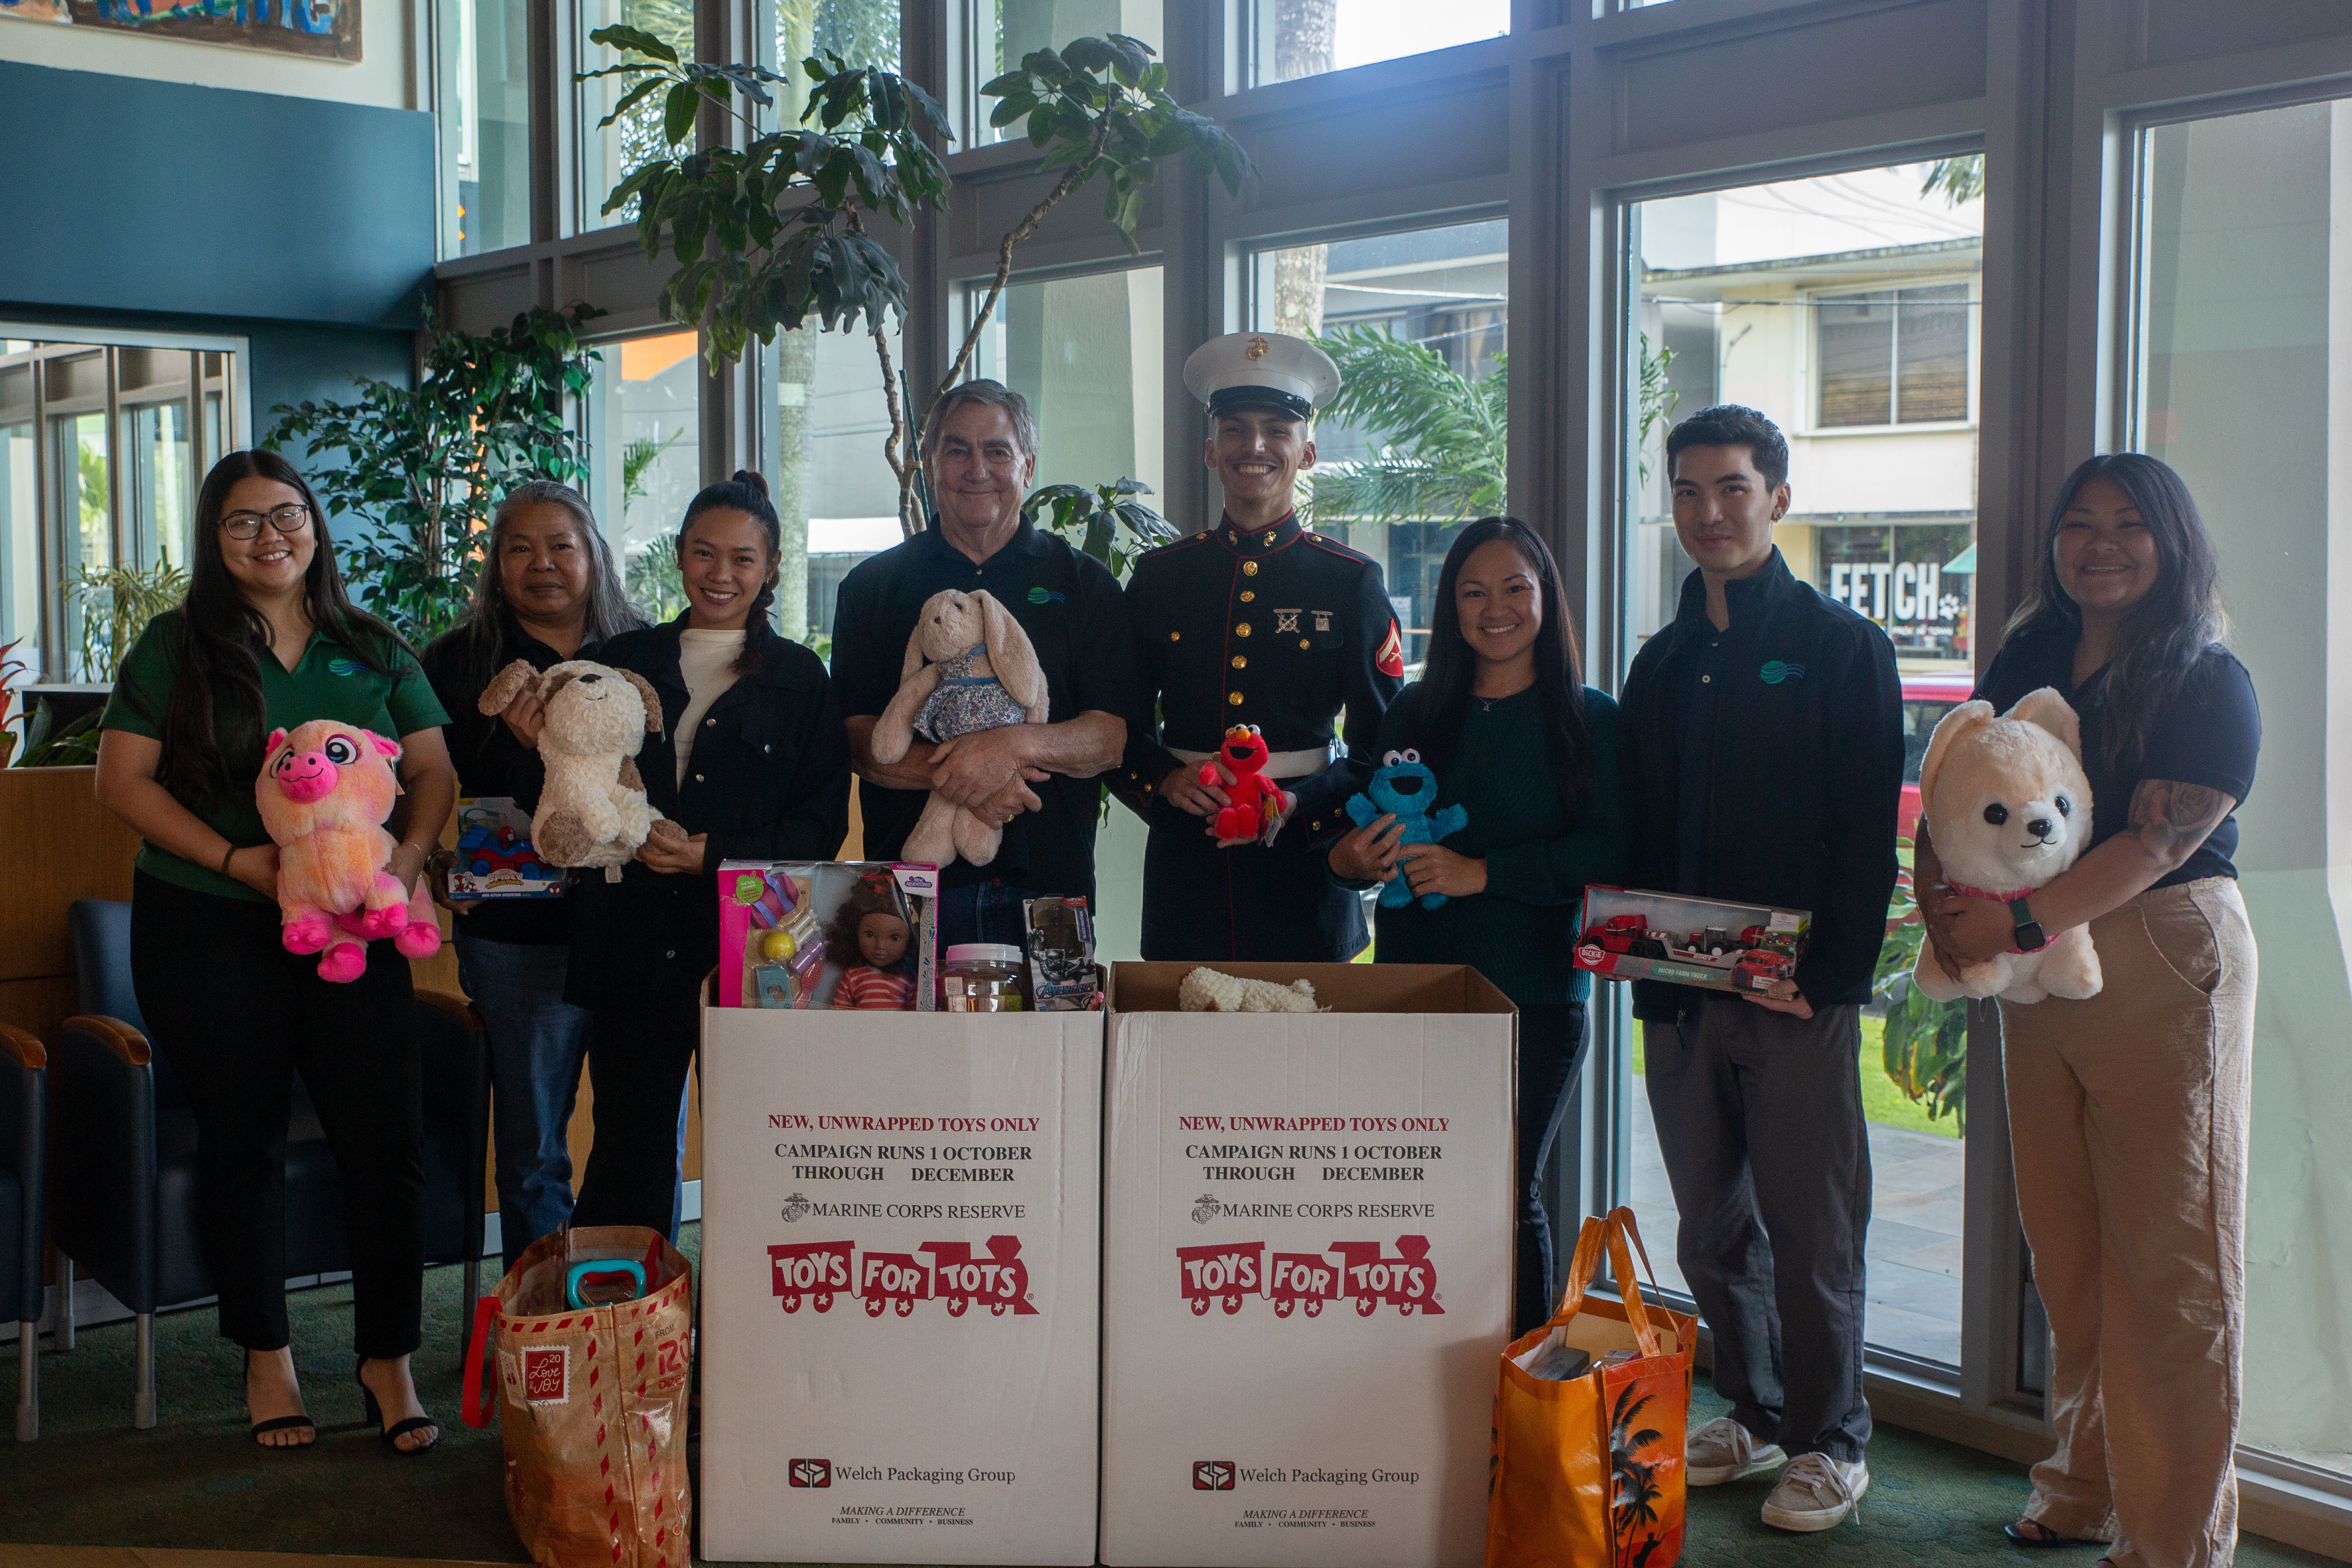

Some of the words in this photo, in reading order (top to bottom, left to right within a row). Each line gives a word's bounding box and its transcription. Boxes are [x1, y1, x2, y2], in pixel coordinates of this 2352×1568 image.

[1830, 562, 1939, 620] FETCH
[1036, 983, 1094, 999] AVENGERS
[769, 1114, 813, 1130] NEW,
[819, 1116, 934, 1131] UNWRAPPED
[938, 1118, 986, 1132] TOYS
[991, 1118, 1039, 1132] ONLY
[1180, 1116, 1225, 1133] NEW,
[1230, 1117, 1346, 1131] UNWRAPPED
[1350, 1117, 1397, 1131] TOYS
[1401, 1118, 1449, 1131] ONLY
[775, 1144, 872, 1159] CAMPAIGN
[878, 1146, 925, 1160] RUNS
[931, 1147, 936, 1160] 1
[943, 1147, 1032, 1161] OCTOBER
[1186, 1145, 1283, 1159] CAMPAIGN
[1290, 1146, 1336, 1159] RUNS
[1343, 1146, 1347, 1159] 1
[1354, 1146, 1442, 1159] OCTOBER
[792, 1166, 883, 1180] THROUGH
[912, 1168, 1014, 1182] DECEMBER
[1203, 1167, 1294, 1180] THROUGH
[1323, 1167, 1424, 1180] DECEMBER
[813, 1203, 882, 1217] MARINE
[886, 1204, 942, 1218] CORPS
[948, 1205, 1025, 1218] RESERVE
[1224, 1204, 1292, 1217] MARINE
[1297, 1204, 1353, 1217] CORPS
[1358, 1204, 1434, 1217] RESERVE
[776, 1251, 847, 1289] TOYS
[864, 1260, 921, 1294] FOR
[940, 1264, 1016, 1298] TOTS
[1185, 1253, 1257, 1290] TOYS
[1274, 1261, 1330, 1295] FOR
[1349, 1264, 1424, 1298] TOTS
[655, 1324, 675, 1339] FROM
[549, 1354, 561, 1363] 20
[529, 1358, 561, 1379] Love
[835, 1466, 882, 1480] Welch
[888, 1467, 964, 1484] Packaging
[968, 1468, 1015, 1485] Group
[1239, 1468, 1287, 1482] Welch
[1292, 1468, 1368, 1485] Packaging
[1371, 1468, 1419, 1485] Group
[840, 1506, 884, 1515] MAKING
[886, 1507, 893, 1516] A
[896, 1507, 965, 1516] DIFFERENCE
[1243, 1510, 1287, 1519] MAKING
[1289, 1510, 1296, 1518] A
[1299, 1509, 1368, 1519] DIFFERENCE
